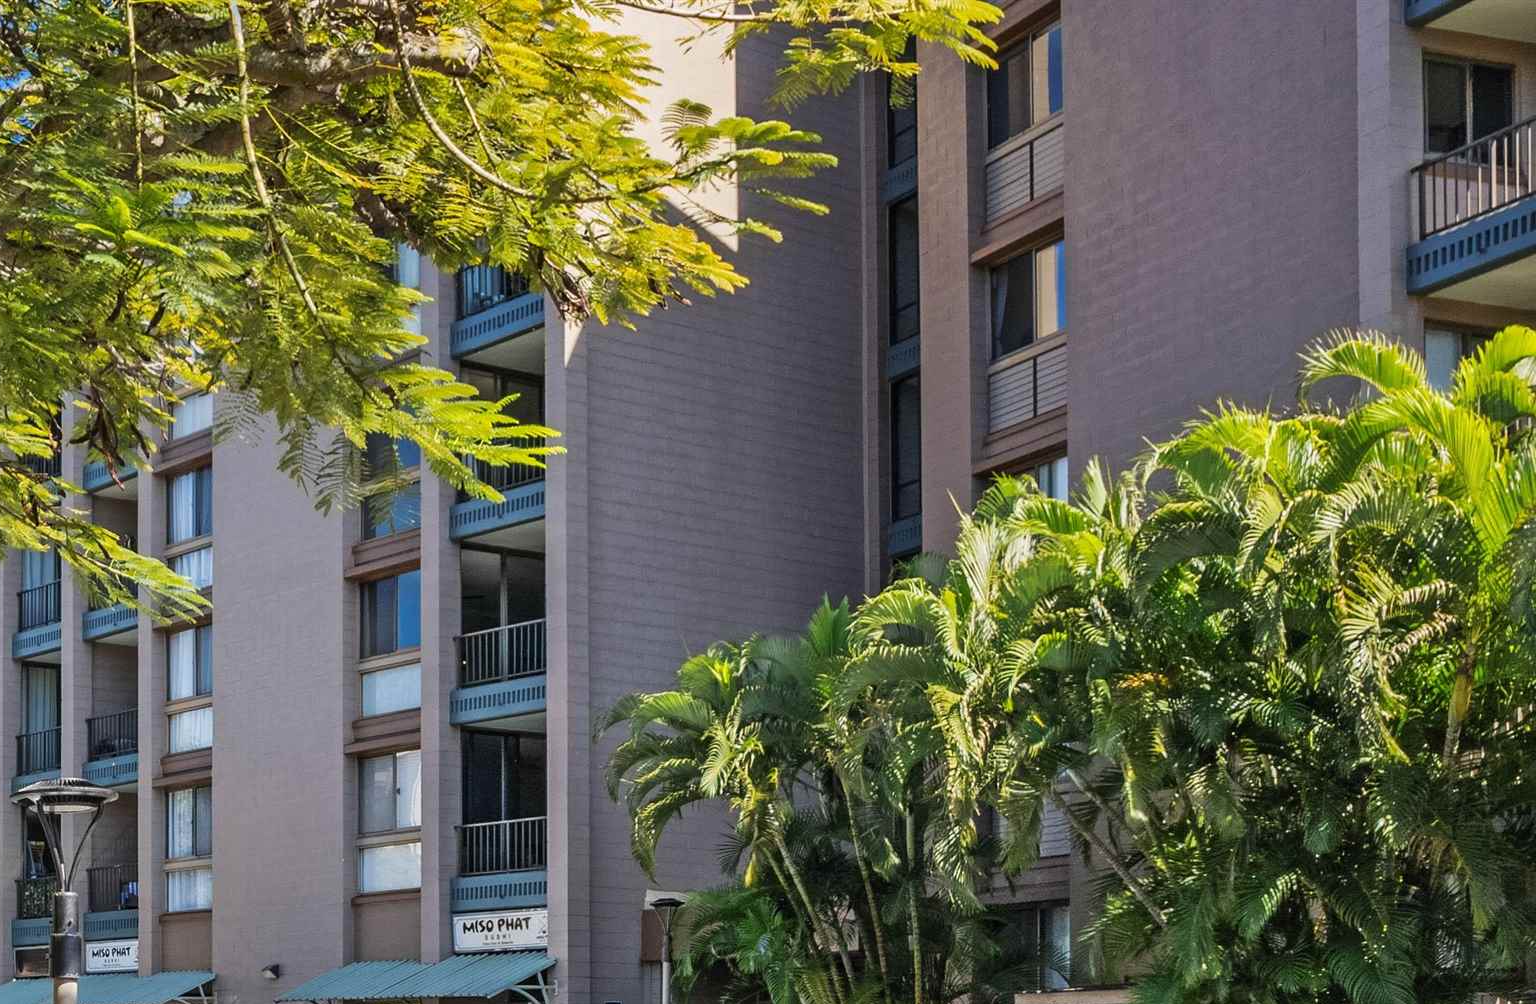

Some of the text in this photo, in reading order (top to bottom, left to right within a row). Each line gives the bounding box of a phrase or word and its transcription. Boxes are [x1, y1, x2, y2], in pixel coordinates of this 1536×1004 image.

[462, 917, 531, 934] MISO PHAT
[92, 946, 130, 958] MISO PHAT
